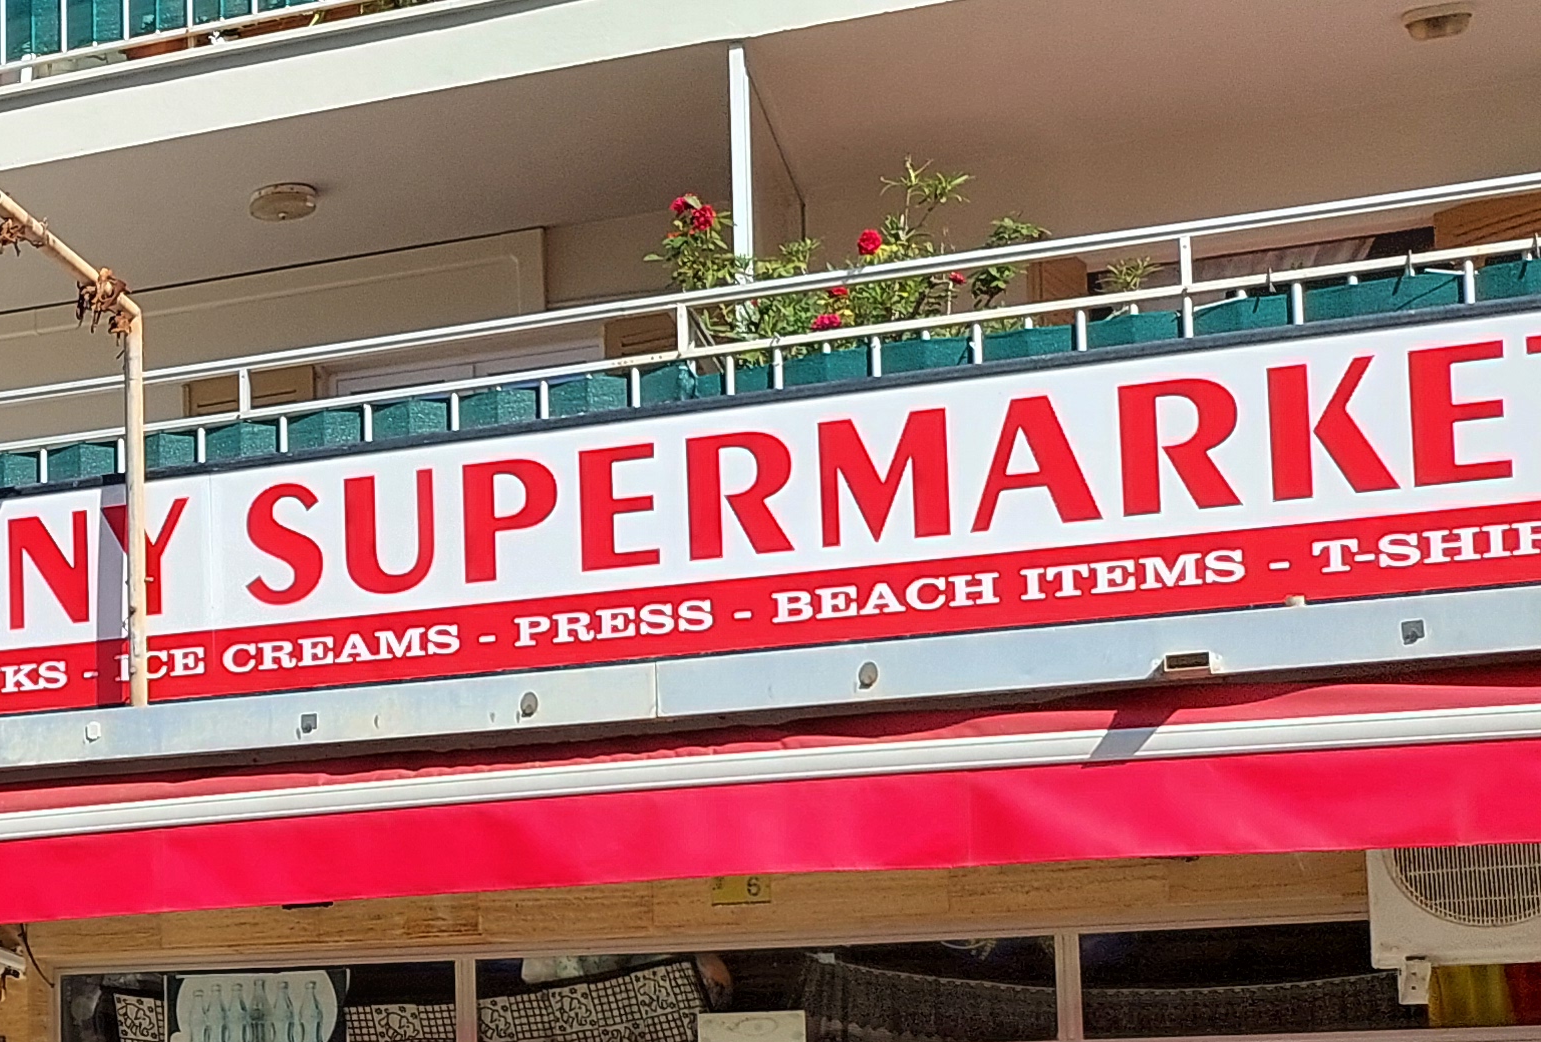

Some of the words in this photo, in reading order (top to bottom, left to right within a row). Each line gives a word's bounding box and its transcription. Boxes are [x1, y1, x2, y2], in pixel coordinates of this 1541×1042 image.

[245, 336, 1541, 606] SUPERMARKE
[114, 646, 206, 682] ICE
[224, 624, 461, 676] CREAMS
[514, 599, 713, 648] PRESS
[772, 574, 999, 625] BEACH
[1020, 549, 1247, 599] ITEMS
